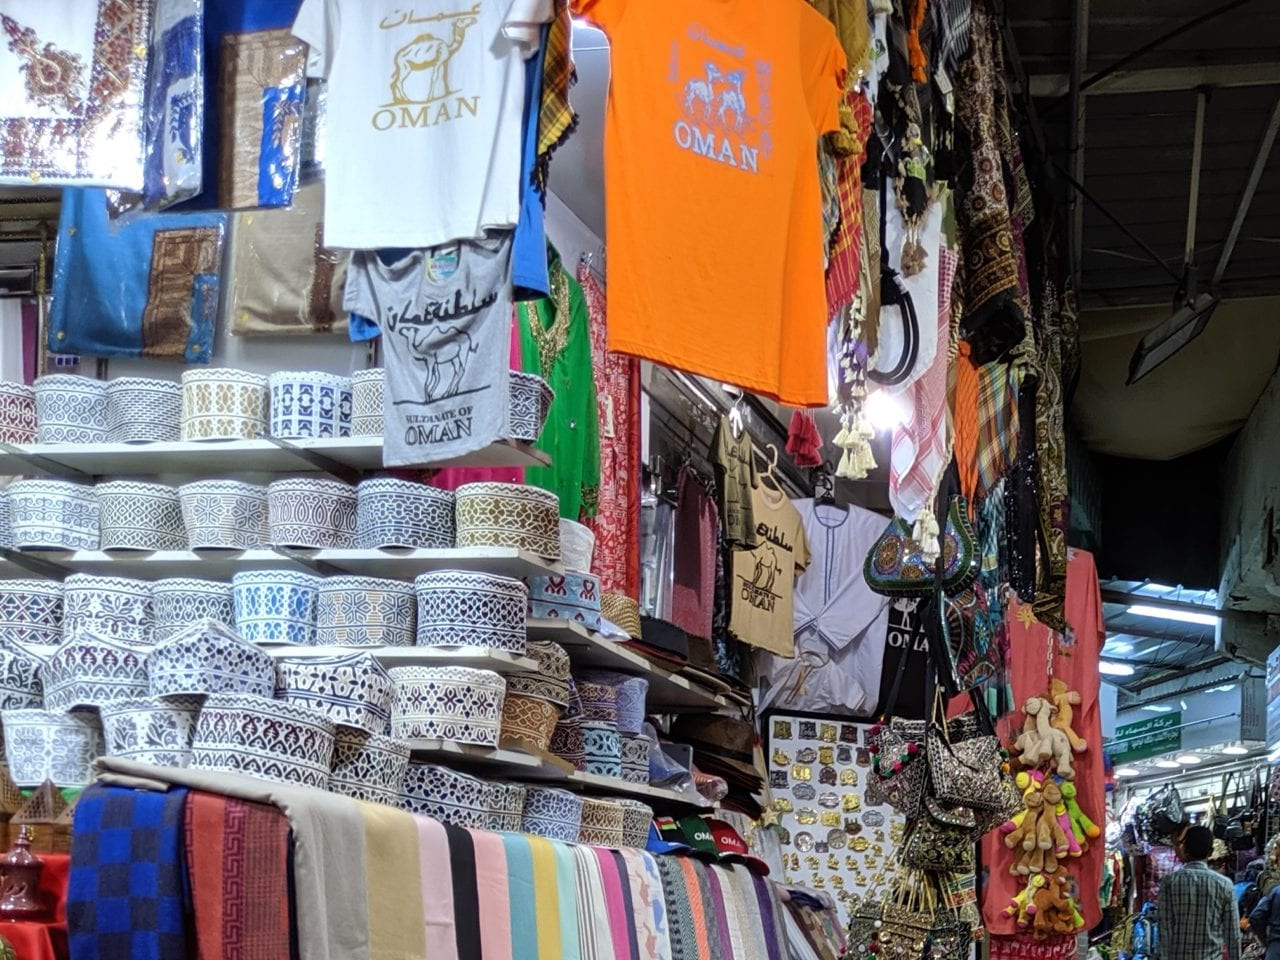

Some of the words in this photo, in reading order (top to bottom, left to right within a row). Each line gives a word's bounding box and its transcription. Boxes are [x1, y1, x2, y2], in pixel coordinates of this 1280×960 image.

[371, 96, 481, 131] OMAN
[674, 120, 759, 174] OMAN
[458, 405, 473, 417] OF
[404, 416, 473, 446] OMAN
[741, 587, 775, 614] OMAN
[888, 631, 930, 652] OMA
